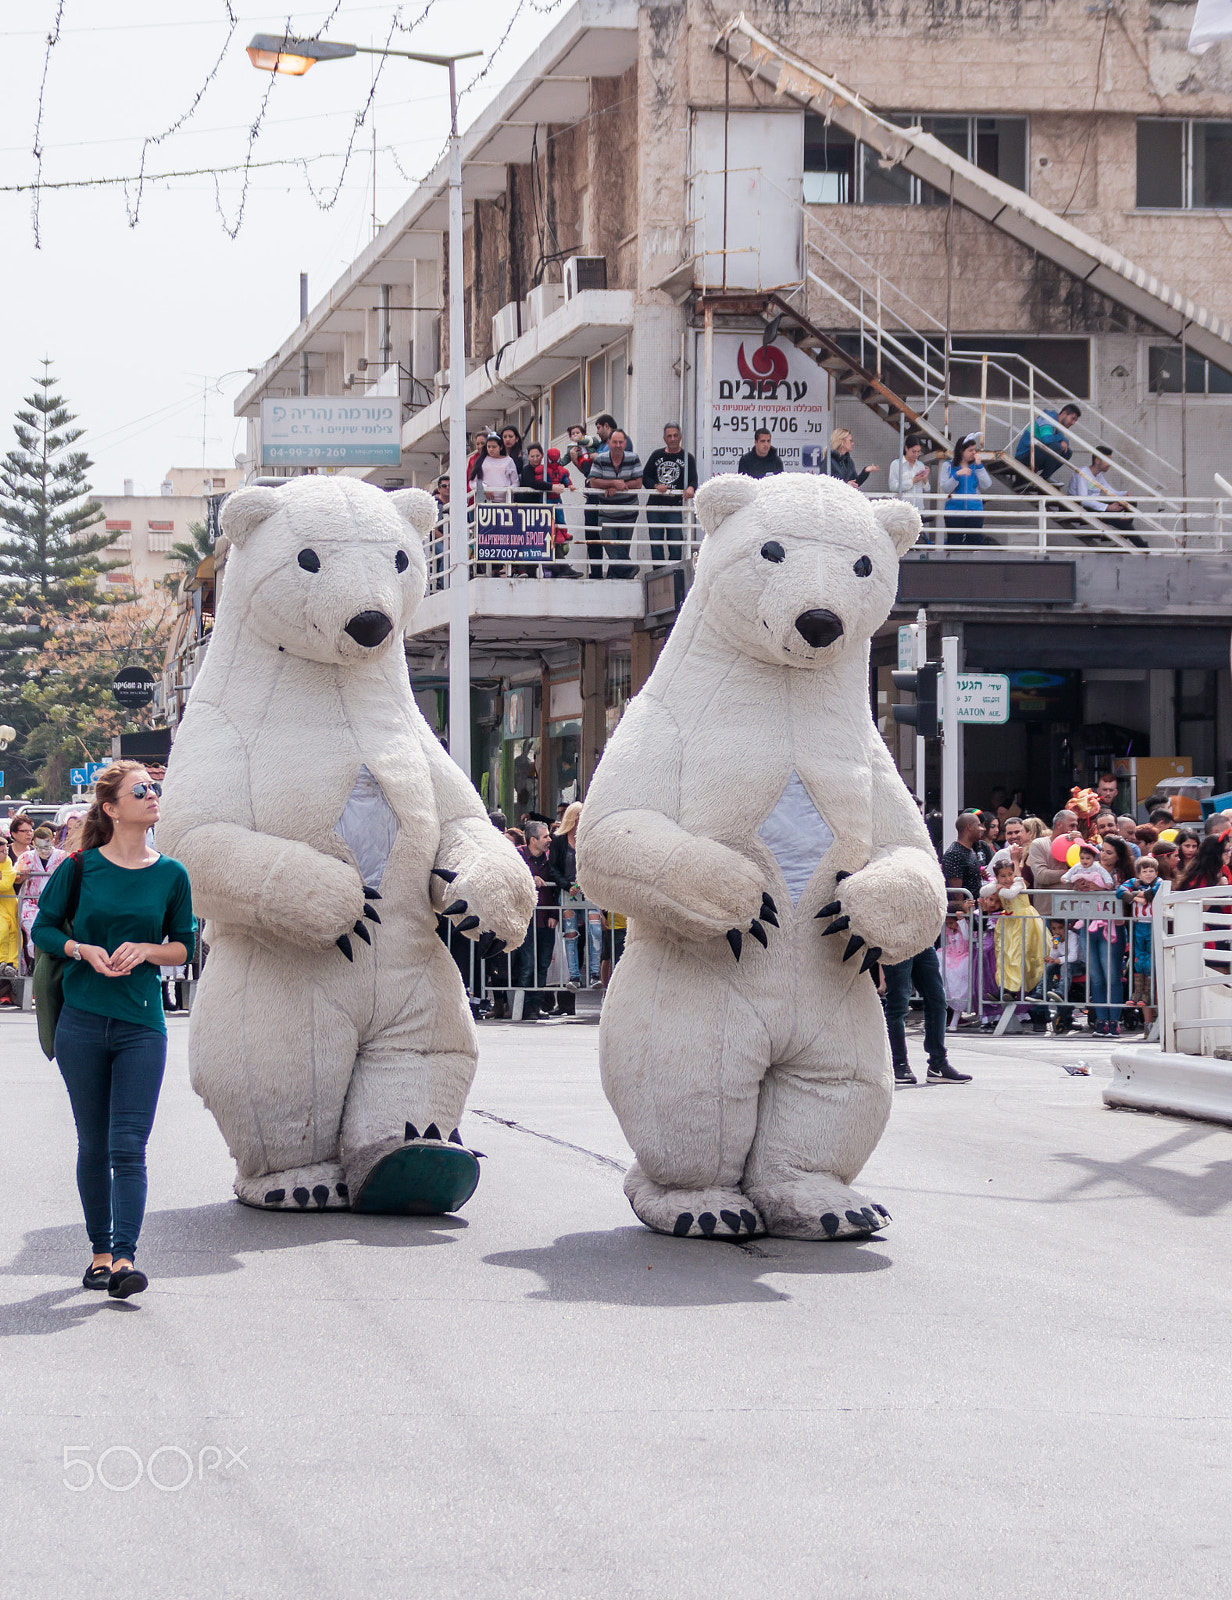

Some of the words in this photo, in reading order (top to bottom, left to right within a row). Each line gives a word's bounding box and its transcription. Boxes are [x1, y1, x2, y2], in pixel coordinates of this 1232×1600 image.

[719, 379, 808, 402] ערבובים
[291, 407, 333, 421] נהריה
[793, 403, 822, 413] המכללה
[291, 425, 312, 434] C.T.
[361, 424, 393, 434] צילומי
[712, 415, 798, 432] 4-9511706
[270, 447, 347, 457] 04-99-29-269
[208, 497, 216, 545] TATTOO
[479, 508, 513, 526] ברוש
[518, 508, 551, 531] תיווך
[526, 532, 544, 545] БРОШ
[479, 549, 517, 558] 9927007
